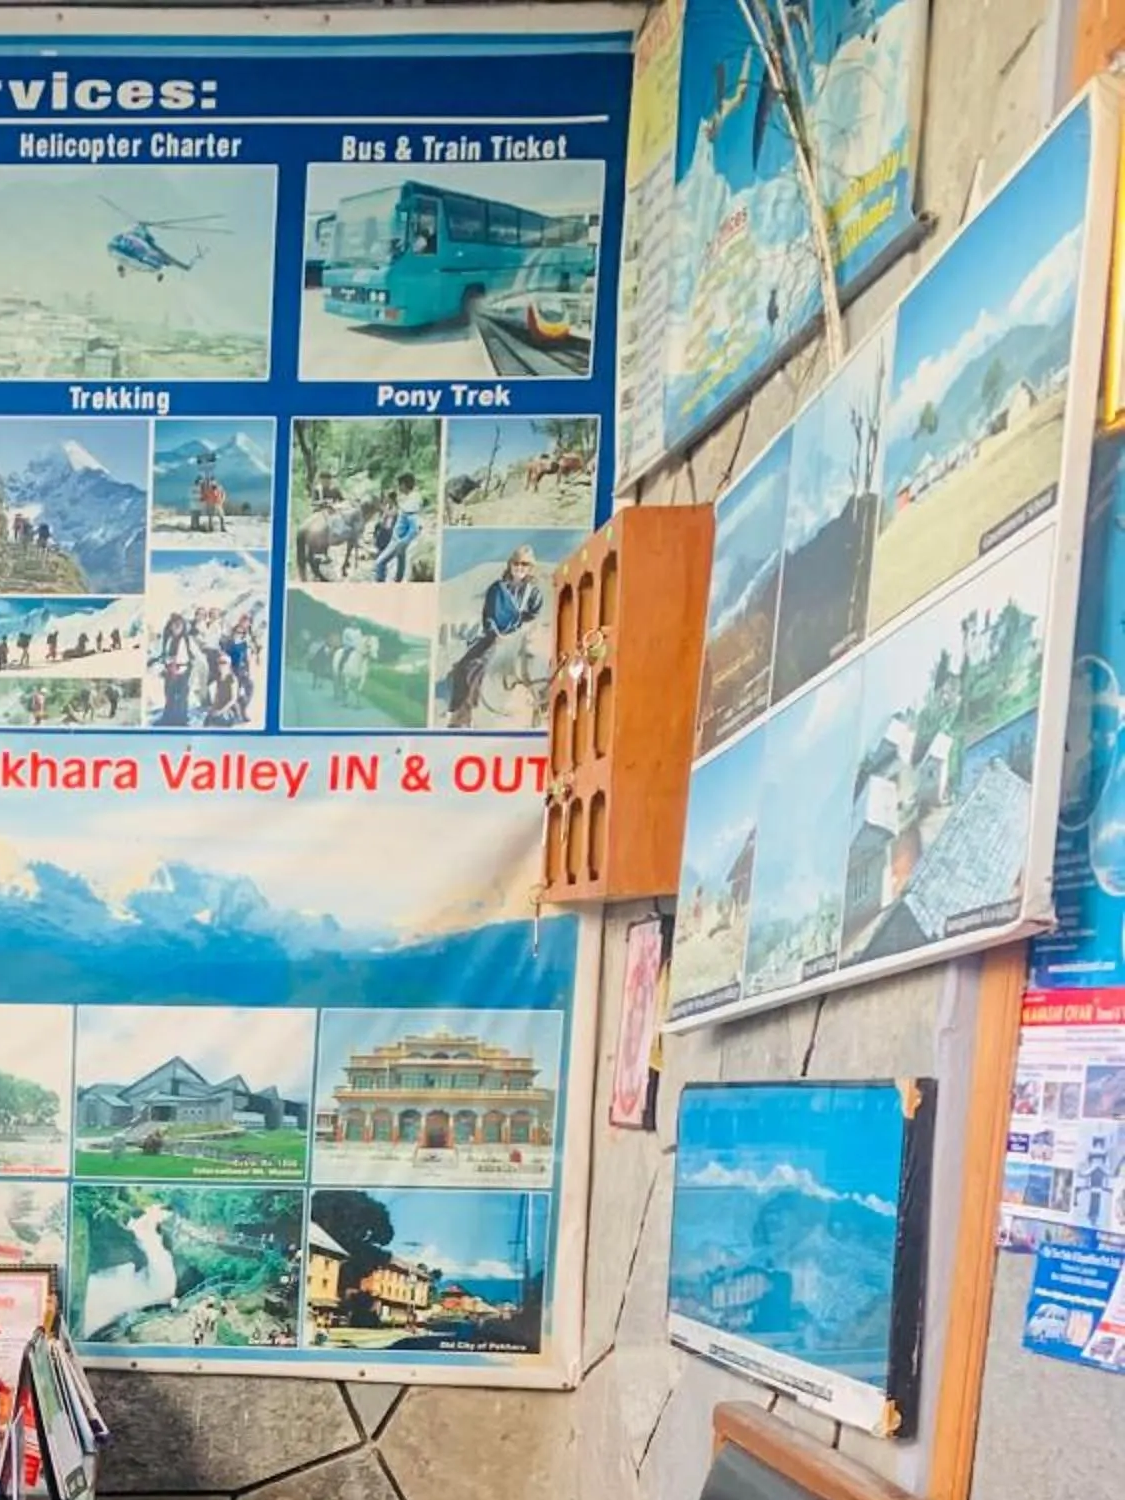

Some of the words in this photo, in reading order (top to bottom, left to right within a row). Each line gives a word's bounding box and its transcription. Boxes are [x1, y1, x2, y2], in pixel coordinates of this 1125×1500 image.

[18, 132, 143, 164] Helicopter
[149, 132, 243, 159] Charter
[341, 135, 387, 161] Bus
[394, 135, 412, 161] &
[421, 135, 482, 161] Train
[489, 134, 568, 161] Ticket
[68, 385, 171, 415] Trekking
[376, 385, 442, 412] Pony
[449, 383, 511, 408] Trek
[159, 753, 309, 799] Valley
[329, 754, 380, 791] IN
[401, 754, 432, 793] &
[453, 754, 550, 794] OUT
